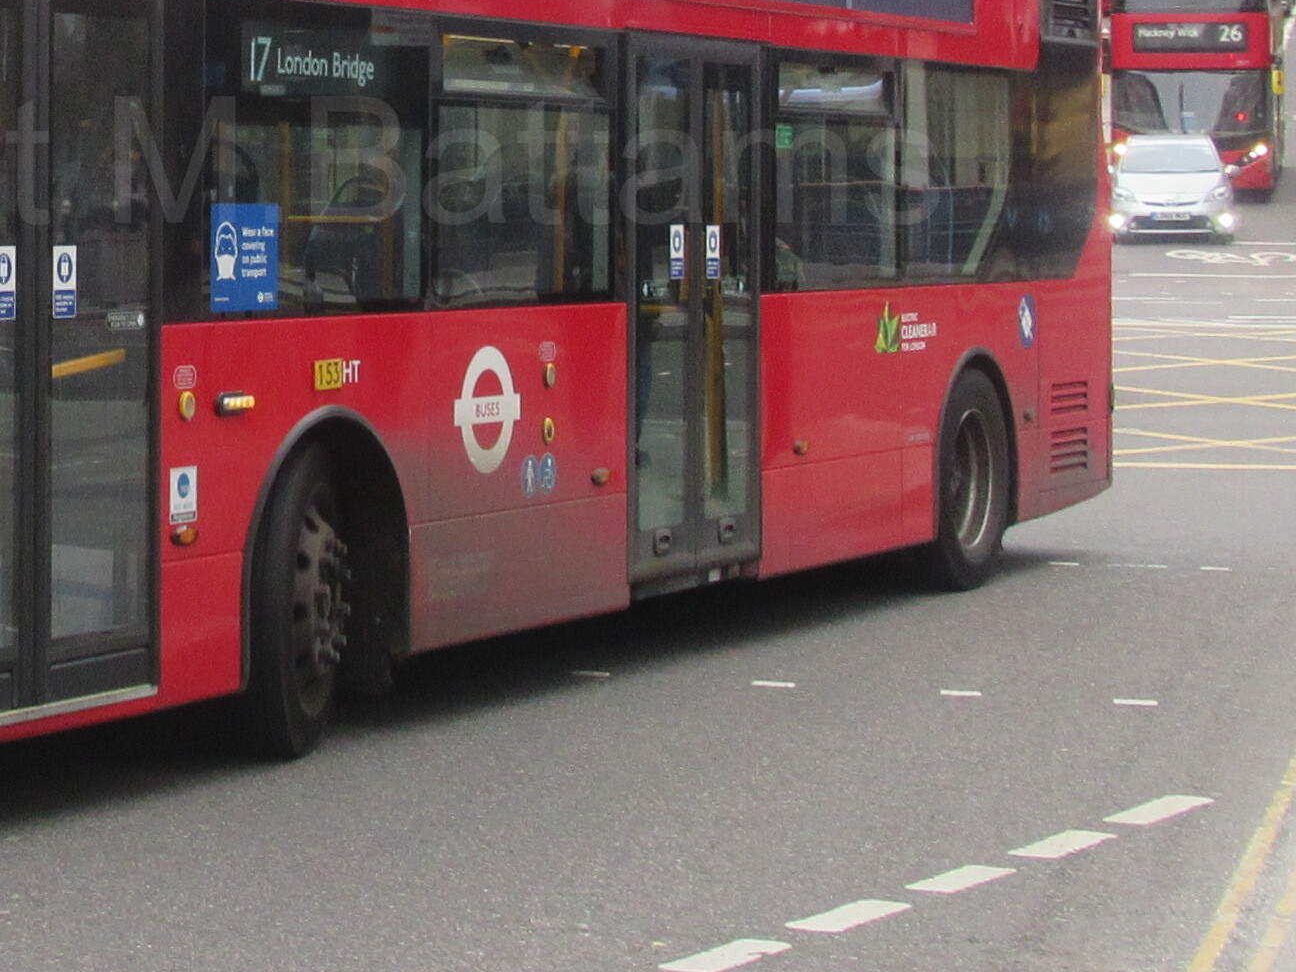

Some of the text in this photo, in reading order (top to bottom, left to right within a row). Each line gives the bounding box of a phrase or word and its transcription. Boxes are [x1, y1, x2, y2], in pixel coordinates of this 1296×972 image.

[1138, 28, 1176, 39] Hackney
[1219, 24, 1243, 42] 26
[250, 36, 375, 87] 17 London Bridge
[318, 359, 361, 386] 153 HT
[475, 402, 500, 418] BUSES
